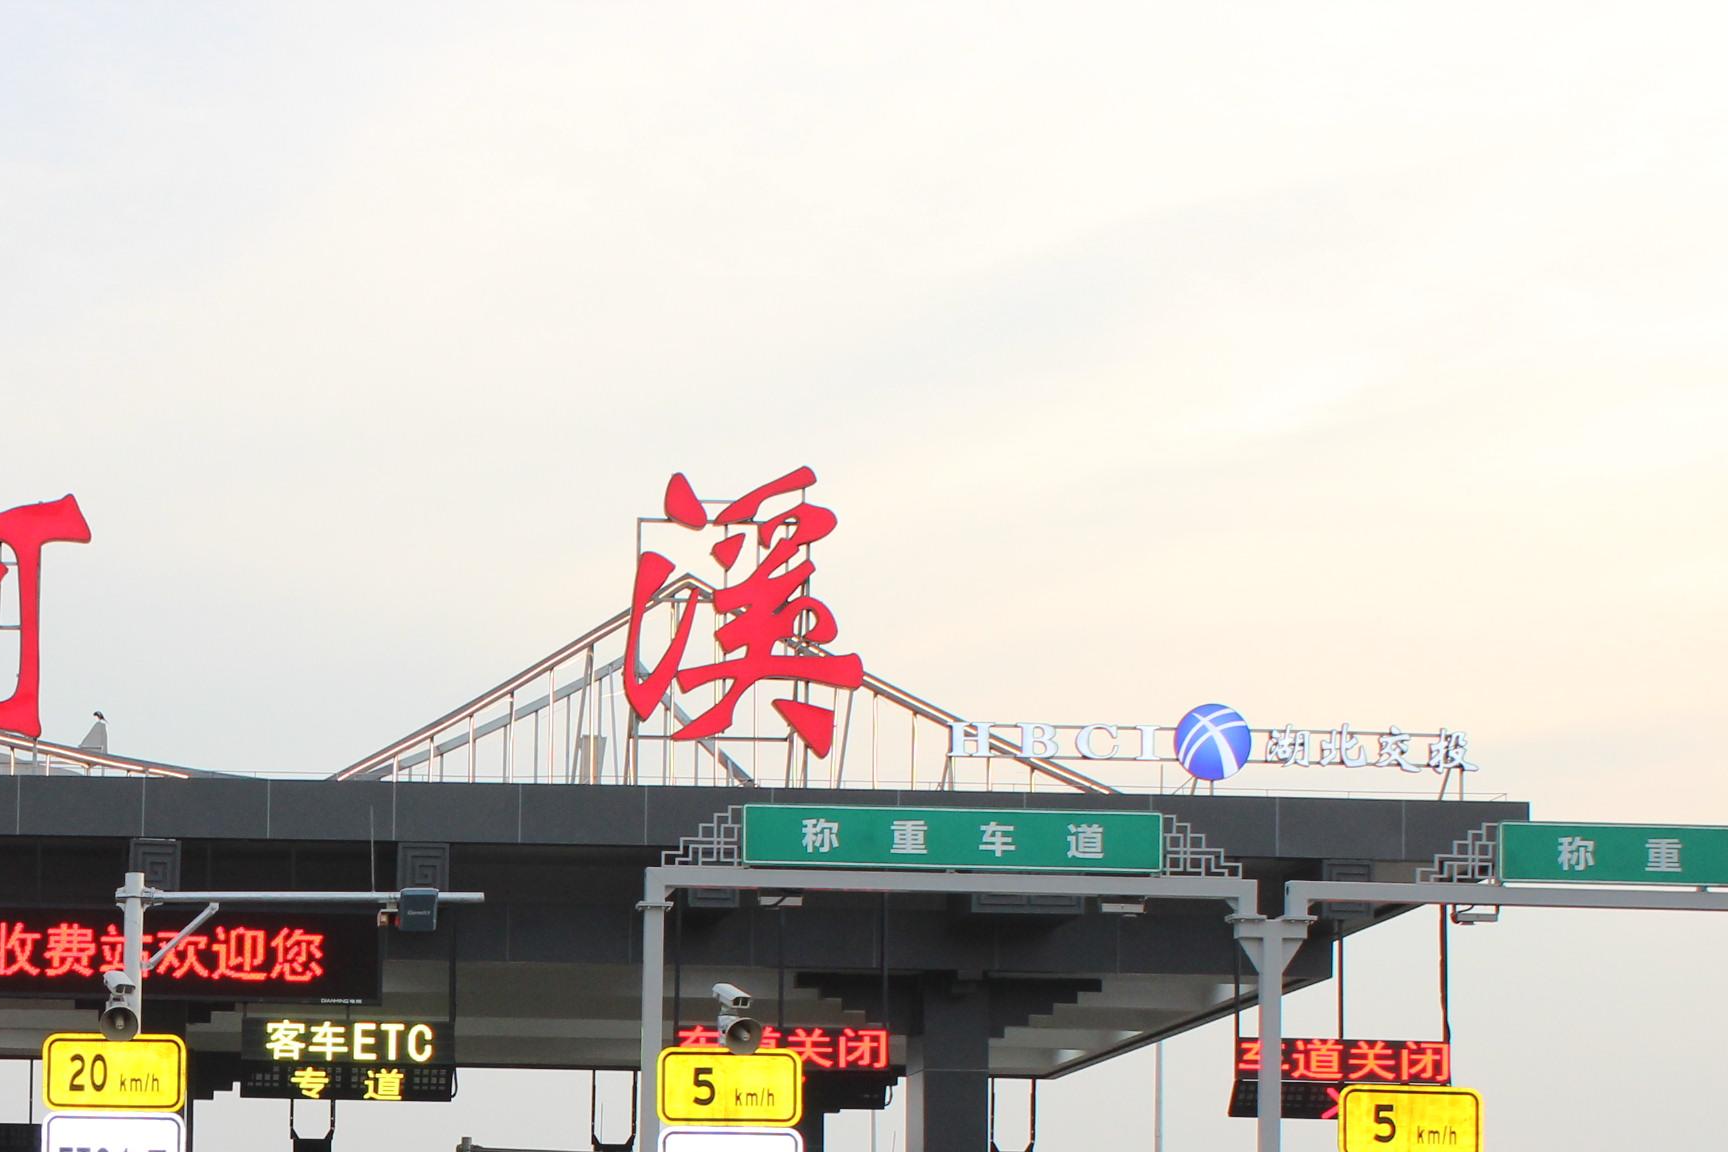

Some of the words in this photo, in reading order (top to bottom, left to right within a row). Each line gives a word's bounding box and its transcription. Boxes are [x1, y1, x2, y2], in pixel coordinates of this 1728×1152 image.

[948, 721, 1161, 758] HBCI
[1266, 723, 1479, 772] 湖北交投
[801, 817, 1105, 860] 称重车道
[1557, 835, 1683, 873] 称重
[264, 1019, 433, 1063] 客车ETC
[68, 1053, 108, 1093] 20
[119, 1073, 161, 1094] km/h
[290, 1067, 405, 1101] 专道
[692, 1066, 716, 1106] 5
[734, 1087, 775, 1107] km/h
[1372, 1103, 1397, 1143] 5
[1416, 1125, 1458, 1145] km/h
